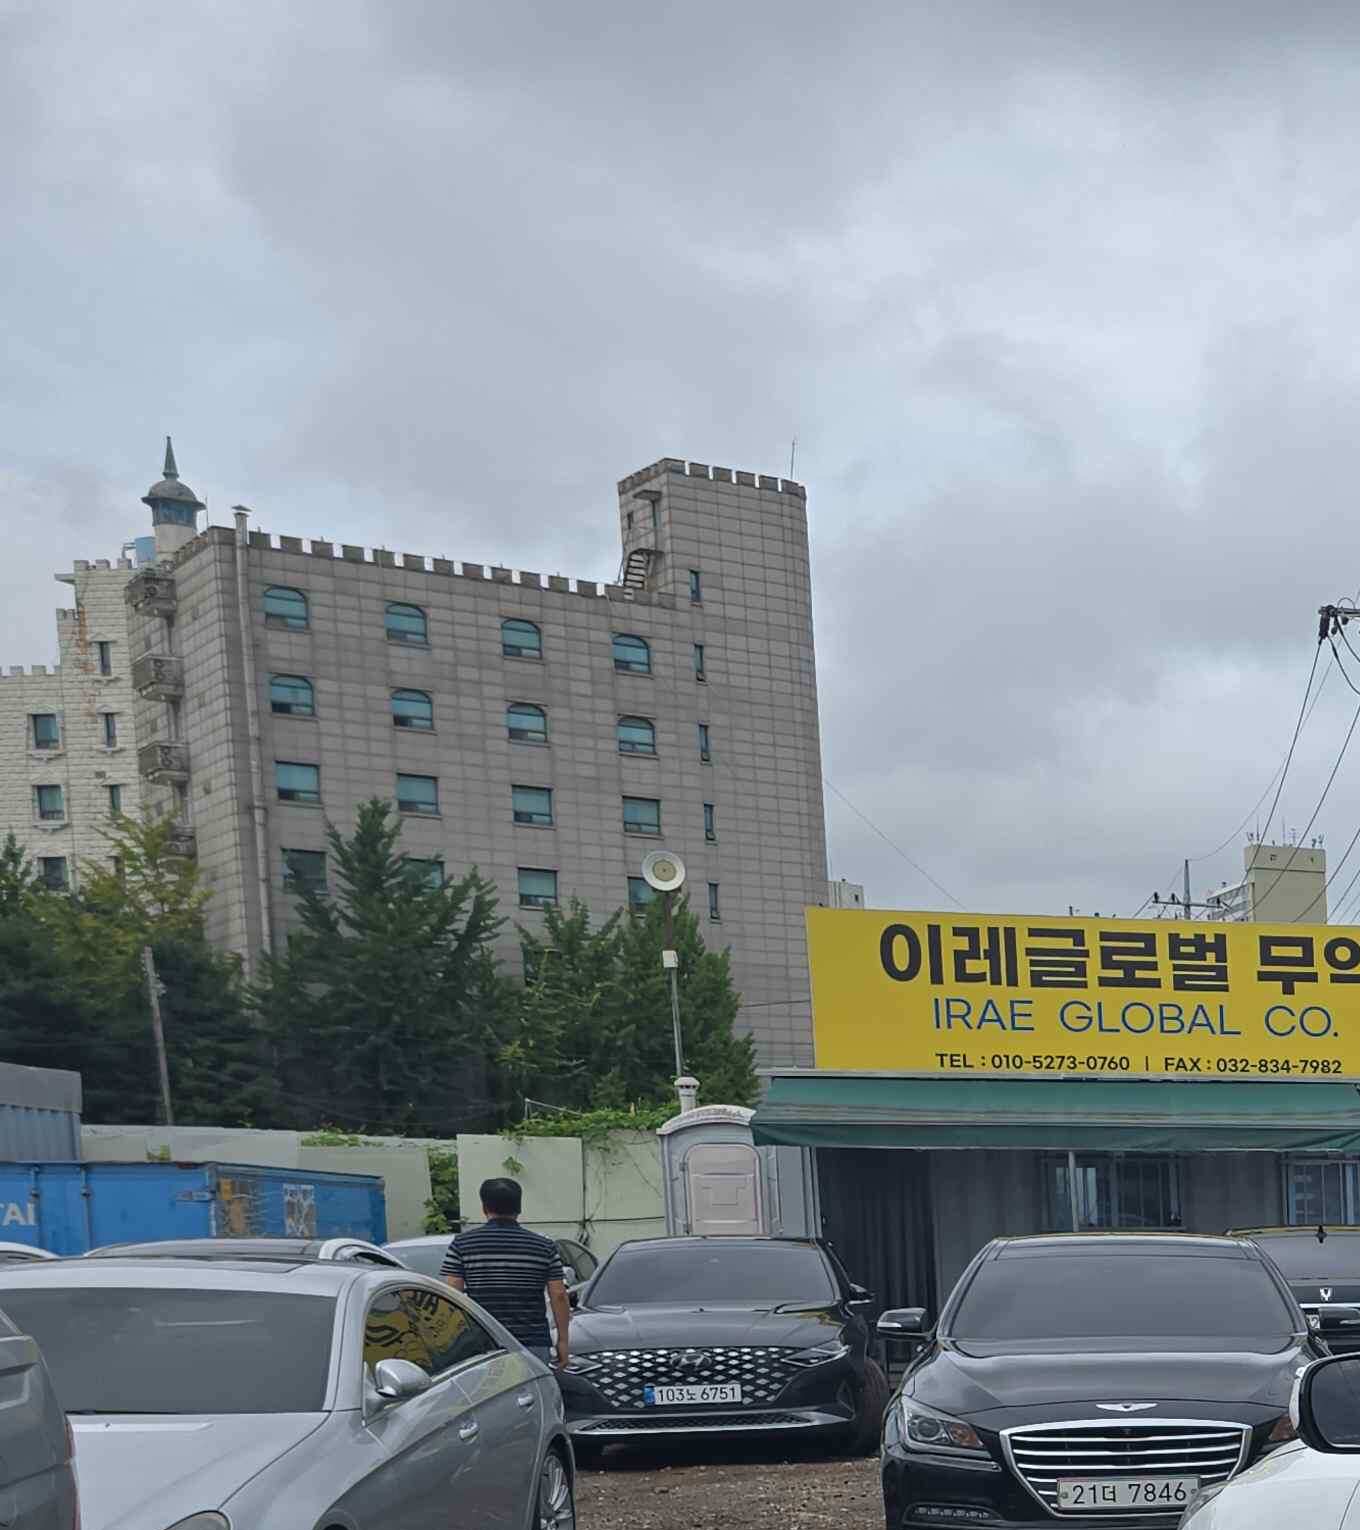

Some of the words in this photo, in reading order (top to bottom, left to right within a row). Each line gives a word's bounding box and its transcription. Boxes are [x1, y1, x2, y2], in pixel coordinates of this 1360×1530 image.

[880, 923, 1230, 993] 이레글로벌
[933, 997, 1035, 1031] IRAE
[1059, 1000, 1242, 1036] GLOBAL
[1264, 1005, 1339, 1037] CO.
[991, 1054, 1130, 1071] 010-5273-0760
[1216, 1058, 1343, 1074] 032-834-7982
[0, 1202, 36, 1226] AI
[700, 1387, 736, 1401] 6751
[1128, 1481, 1187, 1503] 7846
